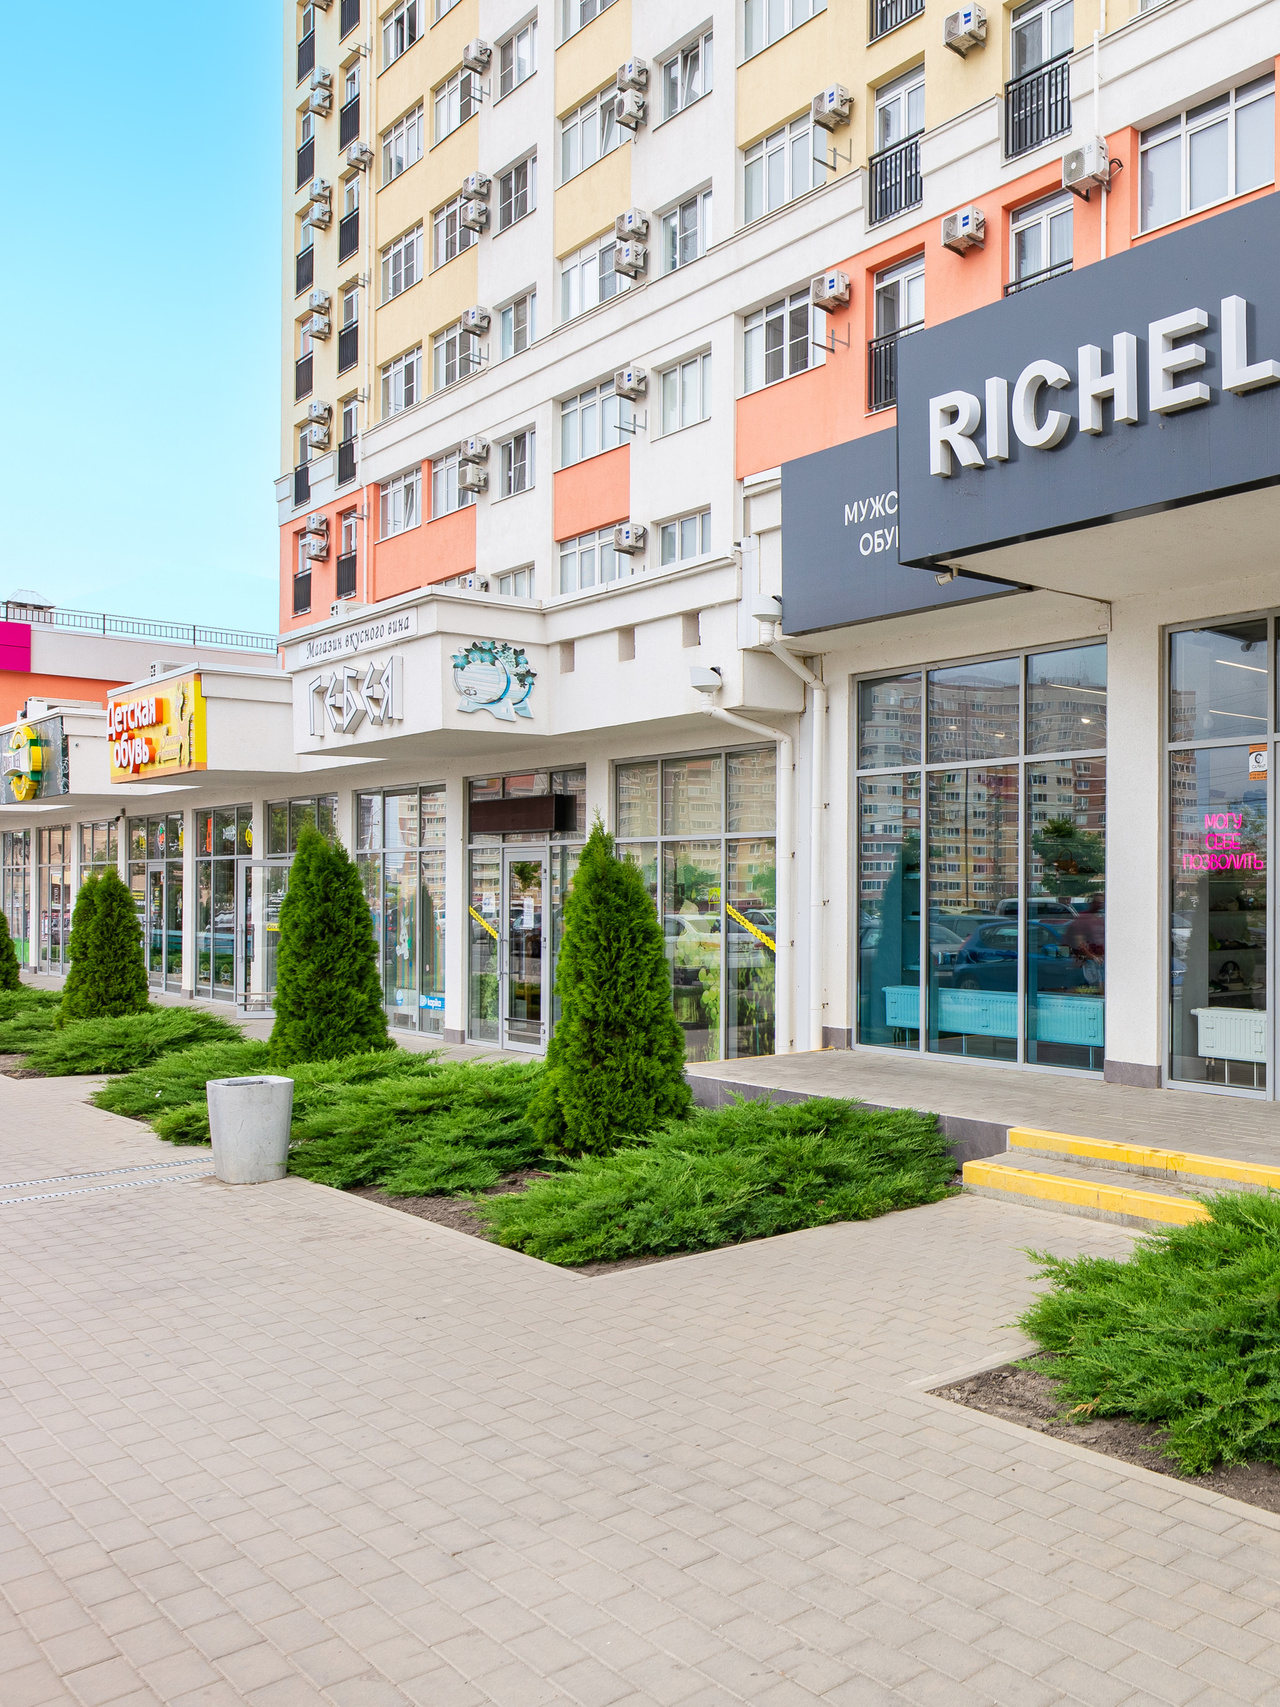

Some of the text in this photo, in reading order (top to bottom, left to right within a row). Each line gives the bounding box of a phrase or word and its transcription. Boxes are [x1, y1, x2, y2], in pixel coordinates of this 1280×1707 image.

[844, 490, 898, 526] МУЖС
[859, 525, 898, 556] ОБУ
[306, 616, 410, 659] Магазин вкусного вина
[309, 655, 404, 736] ГЕБЕЯ
[106, 697, 161, 742] Детская
[114, 732, 156, 773] обувь
[1204, 812, 1243, 830] МОГУ
[1205, 832, 1241, 850] СЕБЕ
[1182, 853, 1264, 870] ПОЗВОЛИТЬ
